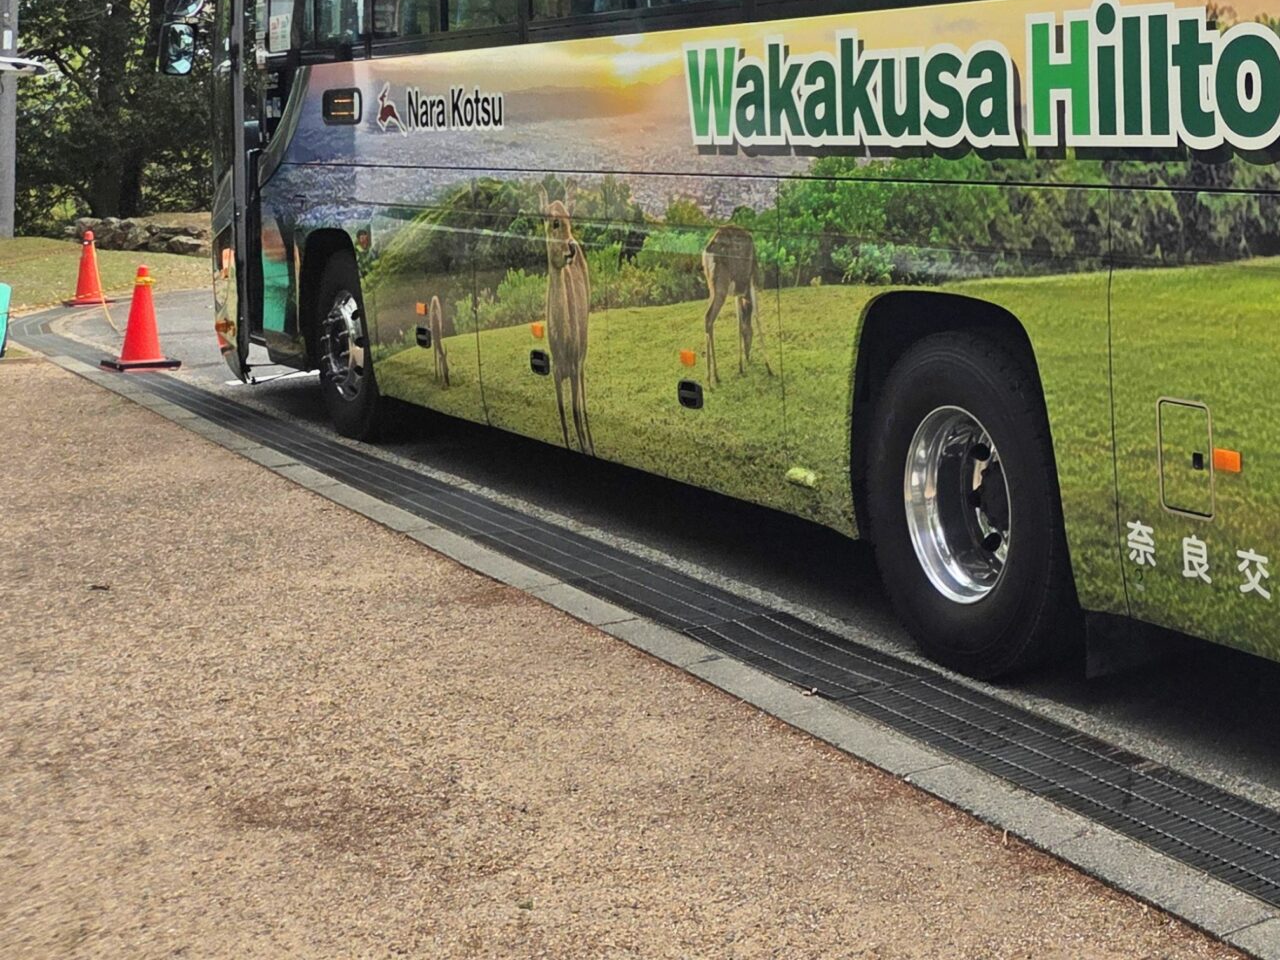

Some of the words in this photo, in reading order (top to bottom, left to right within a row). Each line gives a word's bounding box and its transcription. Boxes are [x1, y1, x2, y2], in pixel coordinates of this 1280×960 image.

[407, 89, 446, 128] Nara
[451, 87, 503, 127] Kotsu
[685, 32, 1014, 143] Wakakusa
